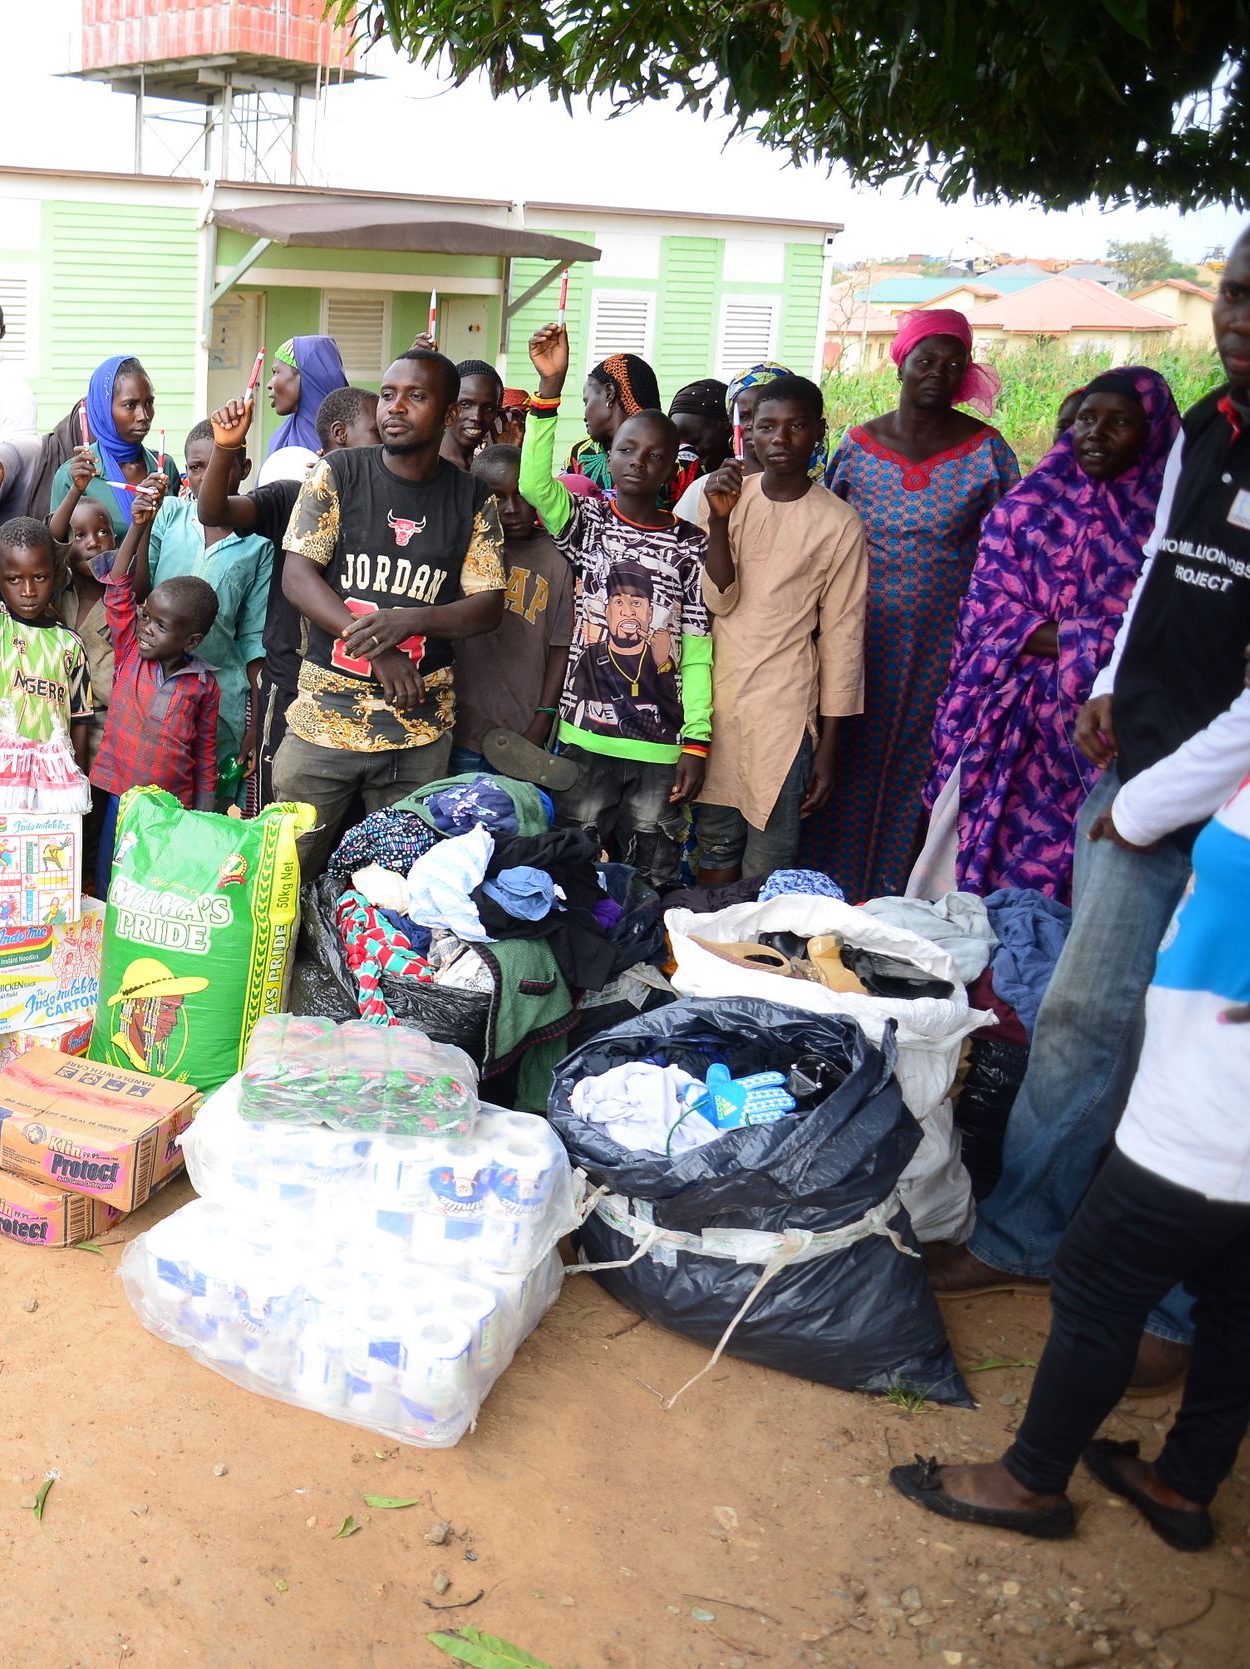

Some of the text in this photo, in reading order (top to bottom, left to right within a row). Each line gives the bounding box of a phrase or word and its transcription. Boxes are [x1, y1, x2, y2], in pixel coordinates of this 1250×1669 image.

[340, 553, 447, 604] JORDAN
[504, 565, 549, 625] AP
[110, 878, 231, 925] MAMA'S
[276, 861, 295, 909] 50kg Net
[117, 907, 210, 952] PRIDE
[0, 953, 39, 965] Instant Noodles
[267, 923, 288, 982] PRIDE
[45, 993, 98, 1018] CARTON
[65, 1061, 156, 1087] HANDLE WITH CARE
[47, 1135, 82, 1160] Klin
[82, 1151, 101, 1161] 99.9%
[50, 1153, 121, 1183] Protect
